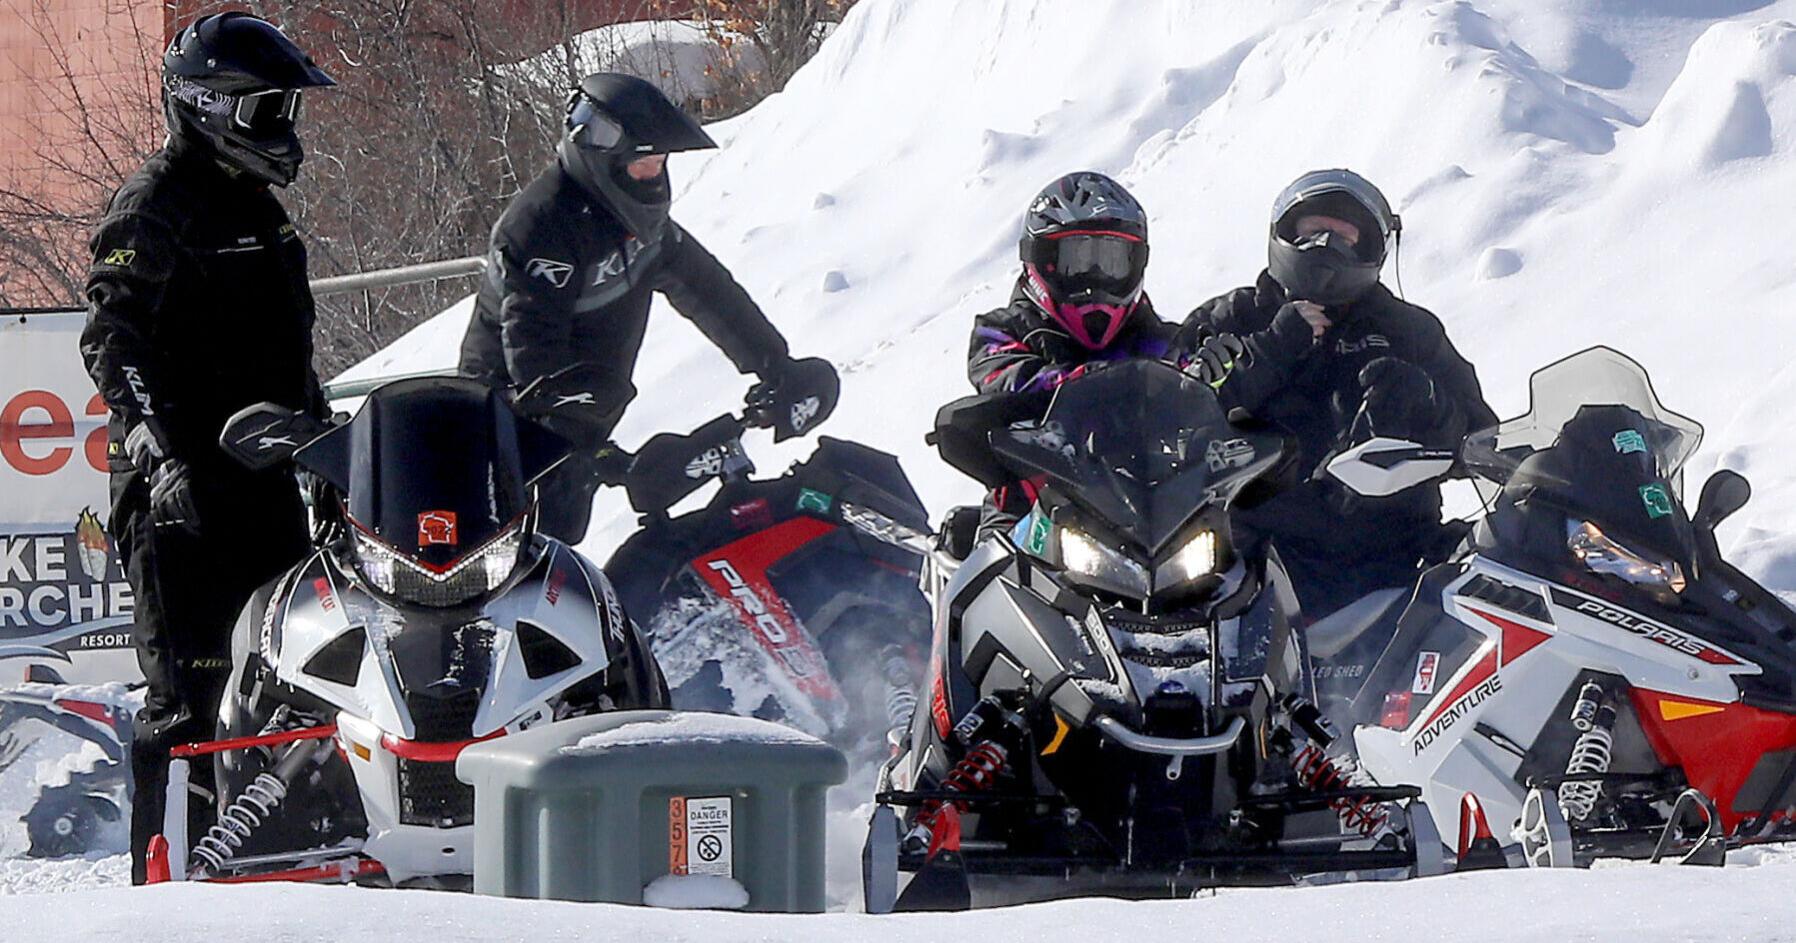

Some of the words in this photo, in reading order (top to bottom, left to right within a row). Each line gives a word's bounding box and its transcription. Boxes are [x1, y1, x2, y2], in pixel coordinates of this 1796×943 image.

[121, 366, 154, 416] KLIM
[80, 634, 131, 647] RESORT
[1577, 600, 1705, 655] POLARIS
[1414, 674, 1502, 757] ADVENTURE
[690, 810, 728, 820] DANGER
